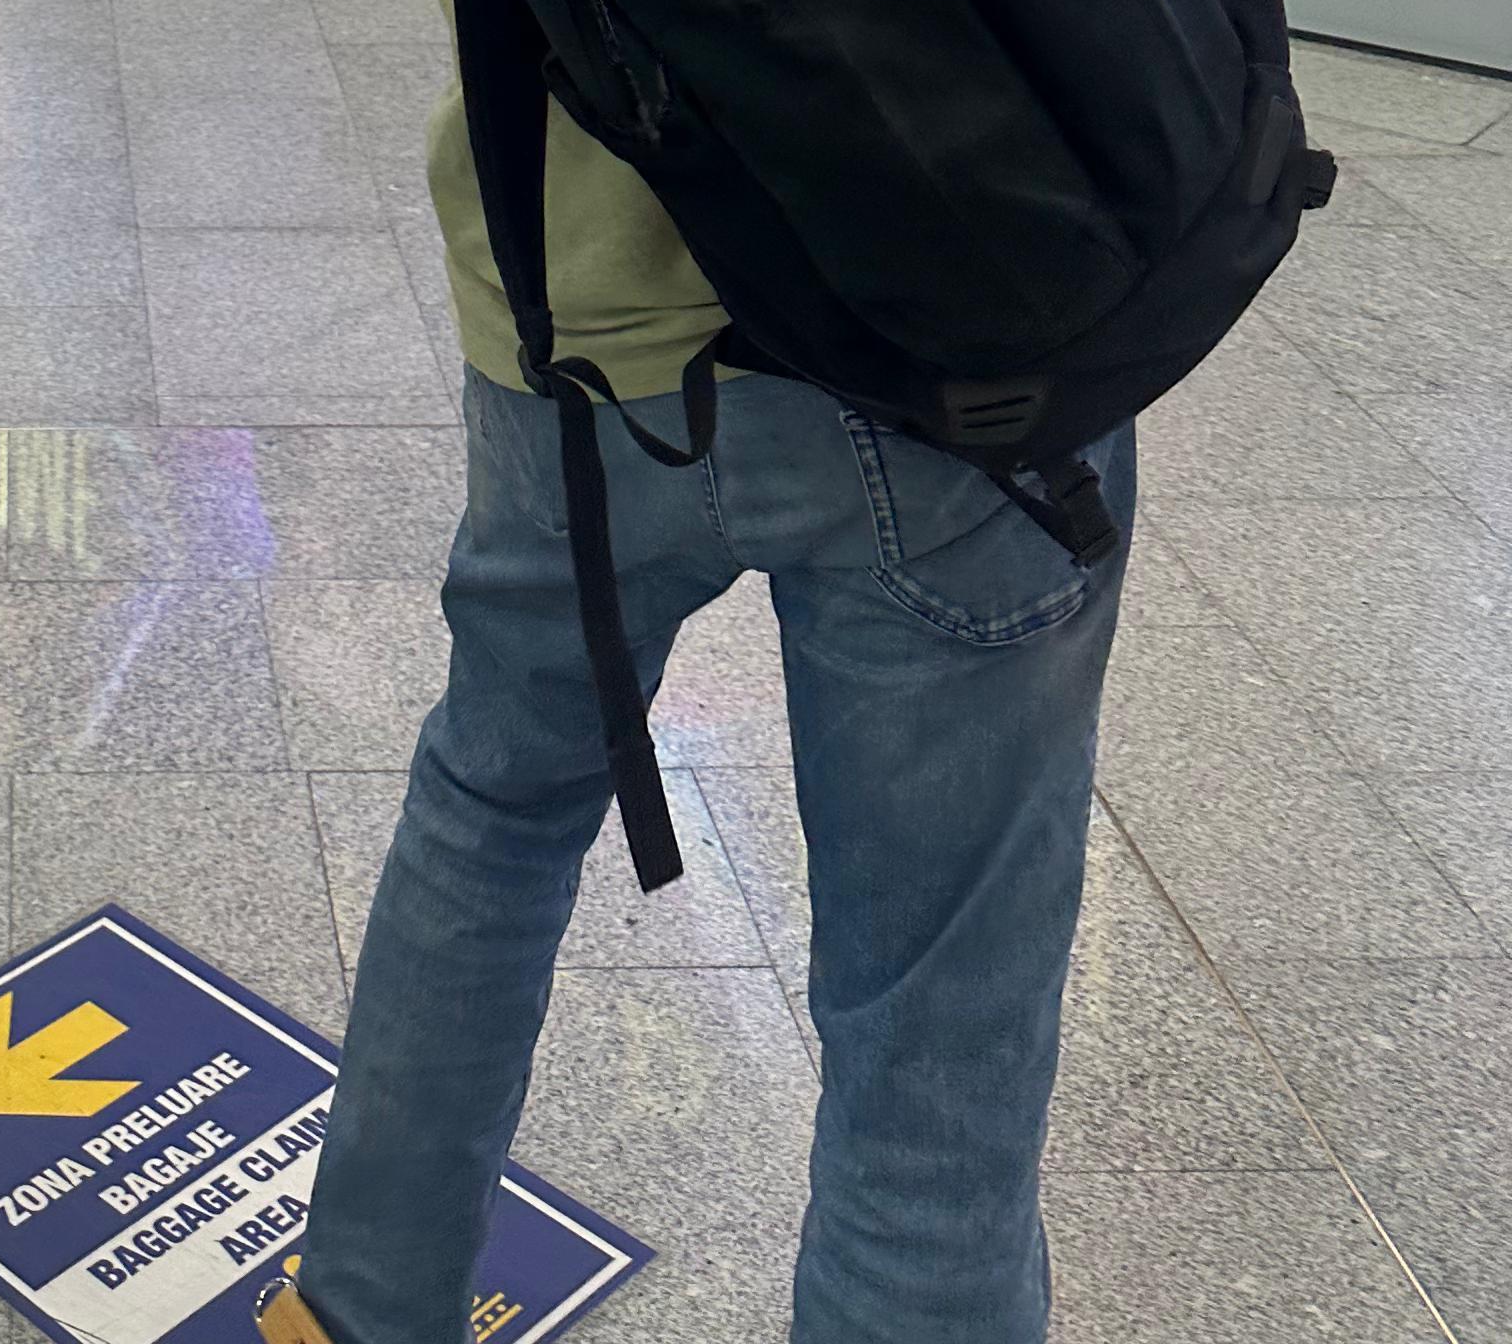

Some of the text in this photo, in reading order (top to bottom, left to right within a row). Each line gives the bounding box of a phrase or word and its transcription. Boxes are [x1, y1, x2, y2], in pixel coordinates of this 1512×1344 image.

[81, 1051, 251, 1165] PRELUARE
[87, 1107, 329, 1290] BAGGAGE CLAIM
[97, 1119, 236, 1214] BAGAJE
[216, 1193, 310, 1265] AREA
